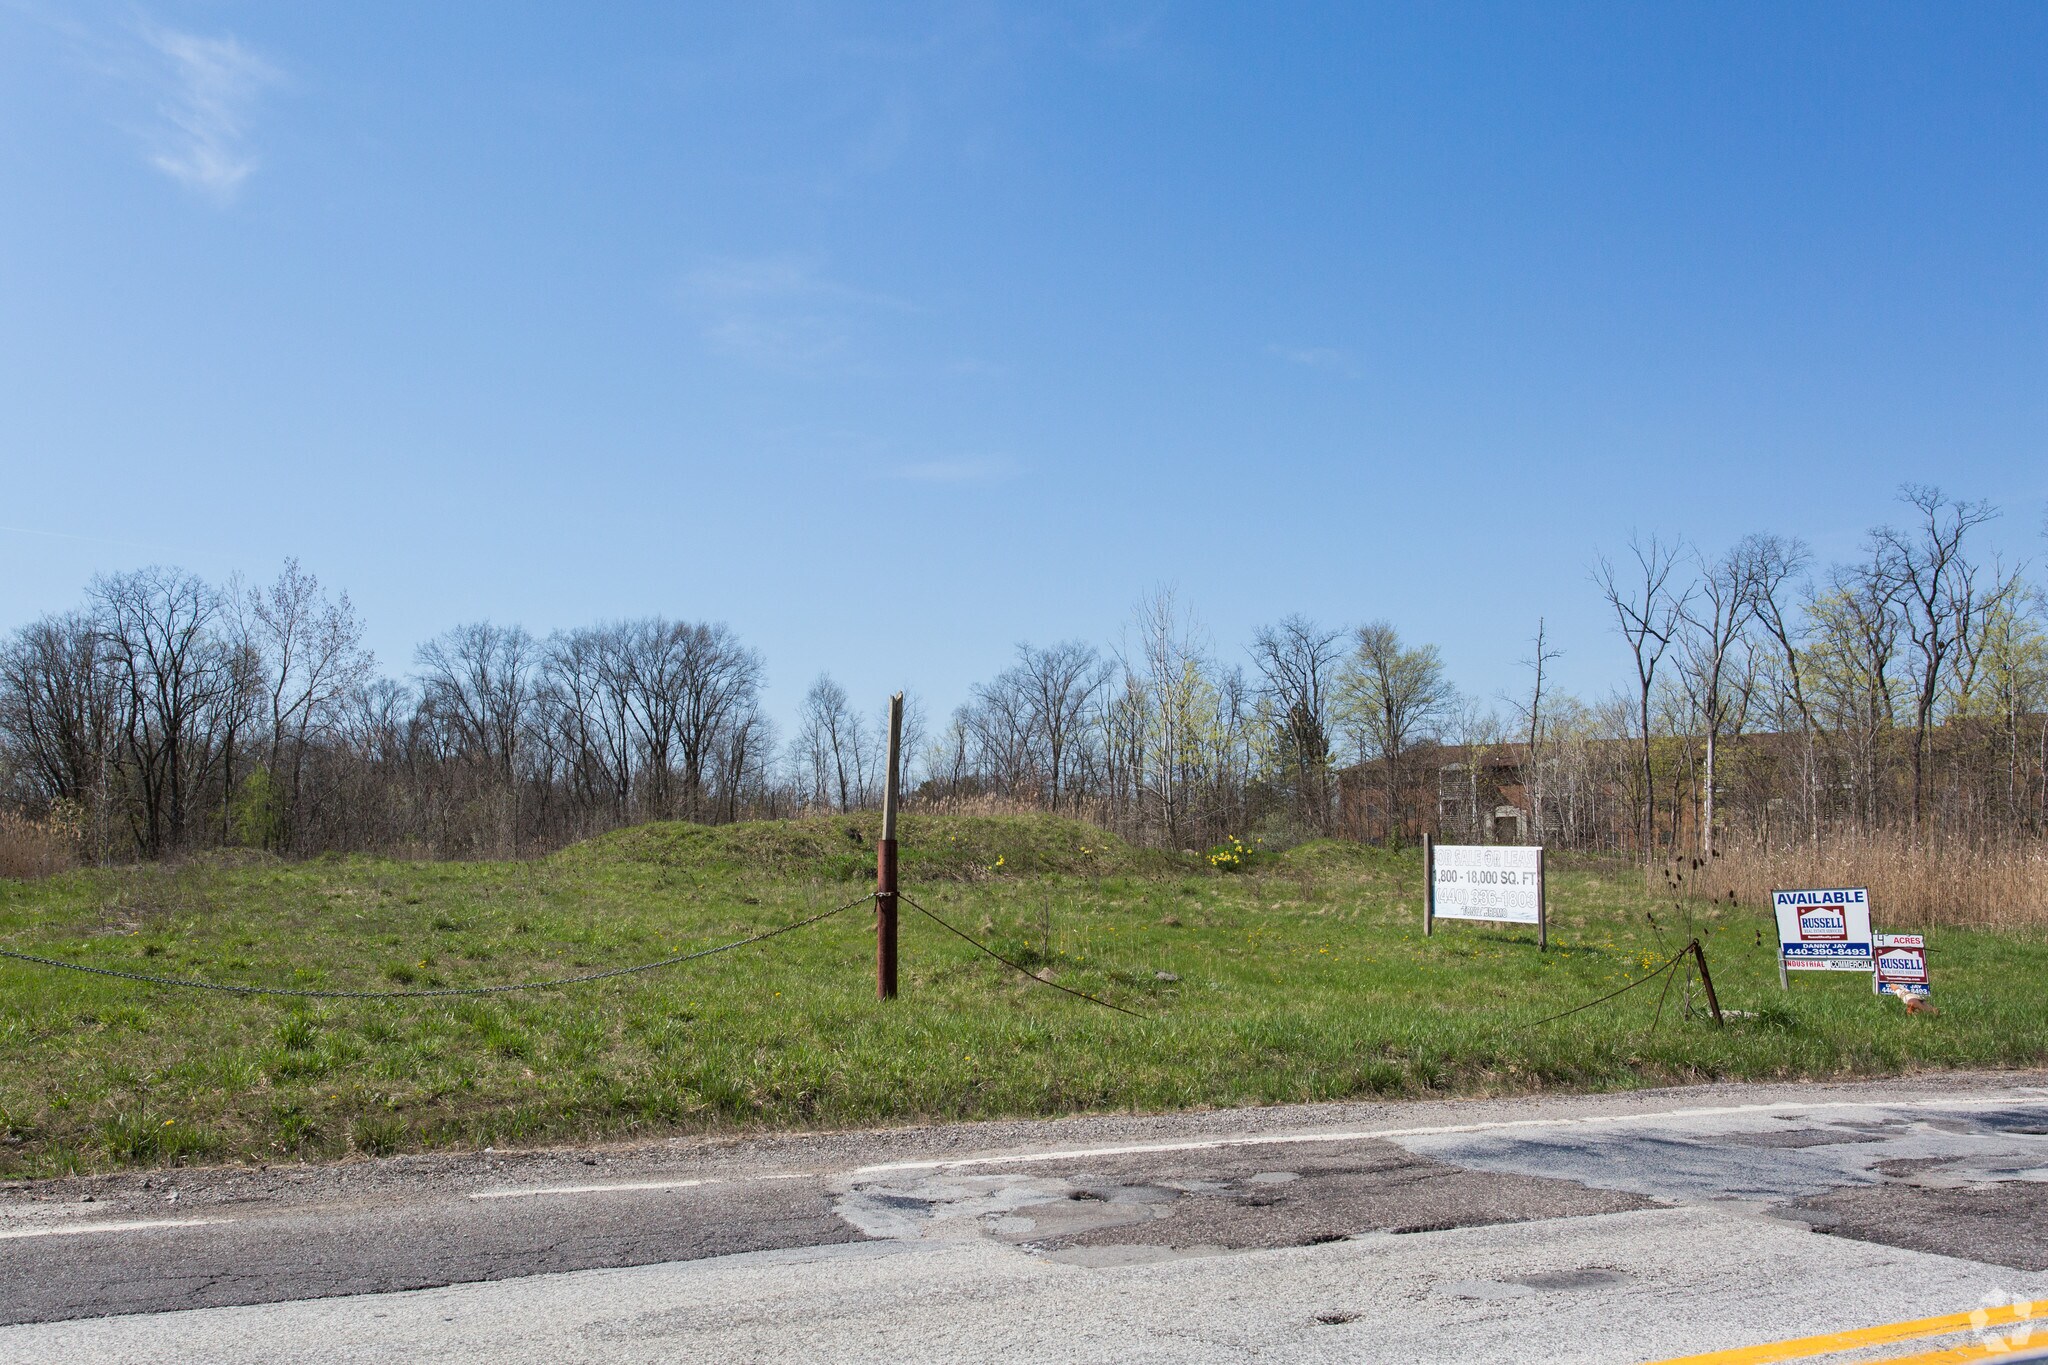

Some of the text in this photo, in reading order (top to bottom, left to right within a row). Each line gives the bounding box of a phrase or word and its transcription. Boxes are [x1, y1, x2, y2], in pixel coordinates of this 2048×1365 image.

[1436, 849, 1538, 869] OR SALE OR LEAS
[1466, 870, 1498, 886] 18,000
[1500, 870, 1520, 886] SQ.
[1436, 888, 1536, 908] (440) 336-1803
[1777, 891, 1864, 904] AVAILABLE
[1802, 917, 1842, 928] RUSSELL
[1893, 936, 1921, 945] ACRES
[1786, 960, 1872, 969] NDUSTRIAL COMMERCIAL
[1880, 958, 1922, 970] RUSSELL
